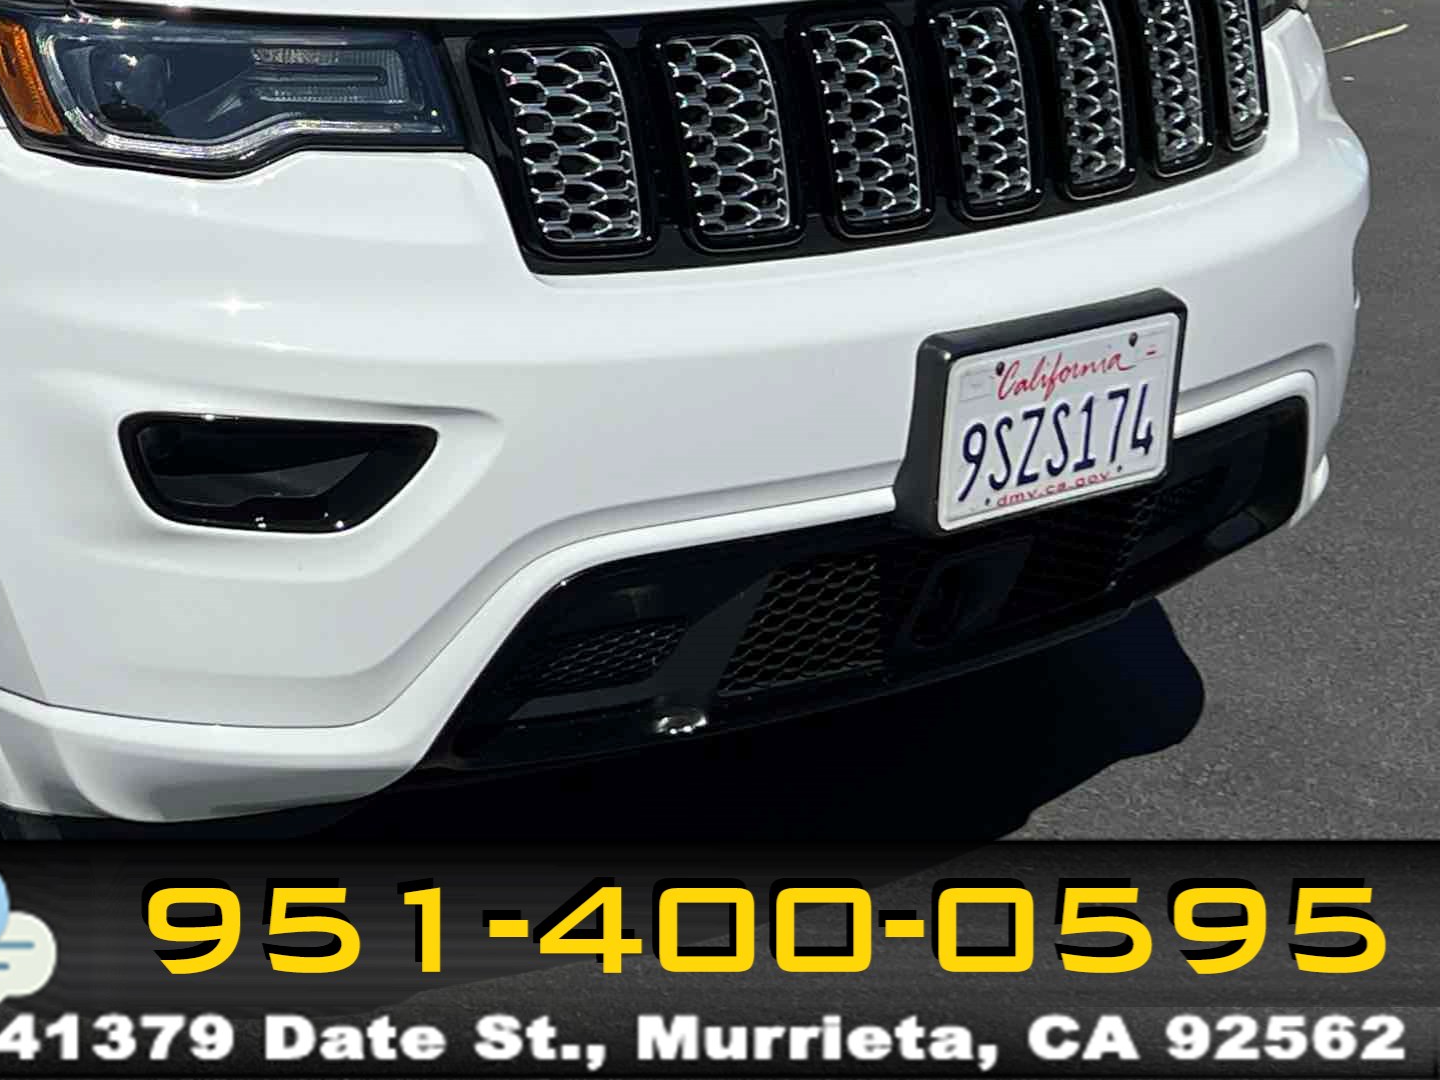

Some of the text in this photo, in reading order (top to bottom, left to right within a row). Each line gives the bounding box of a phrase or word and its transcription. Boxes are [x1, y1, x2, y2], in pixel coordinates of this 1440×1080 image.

[996, 351, 1136, 402] California
[957, 383, 1154, 503] 9SZS174
[996, 471, 1111, 508] dmv.ca.gov
